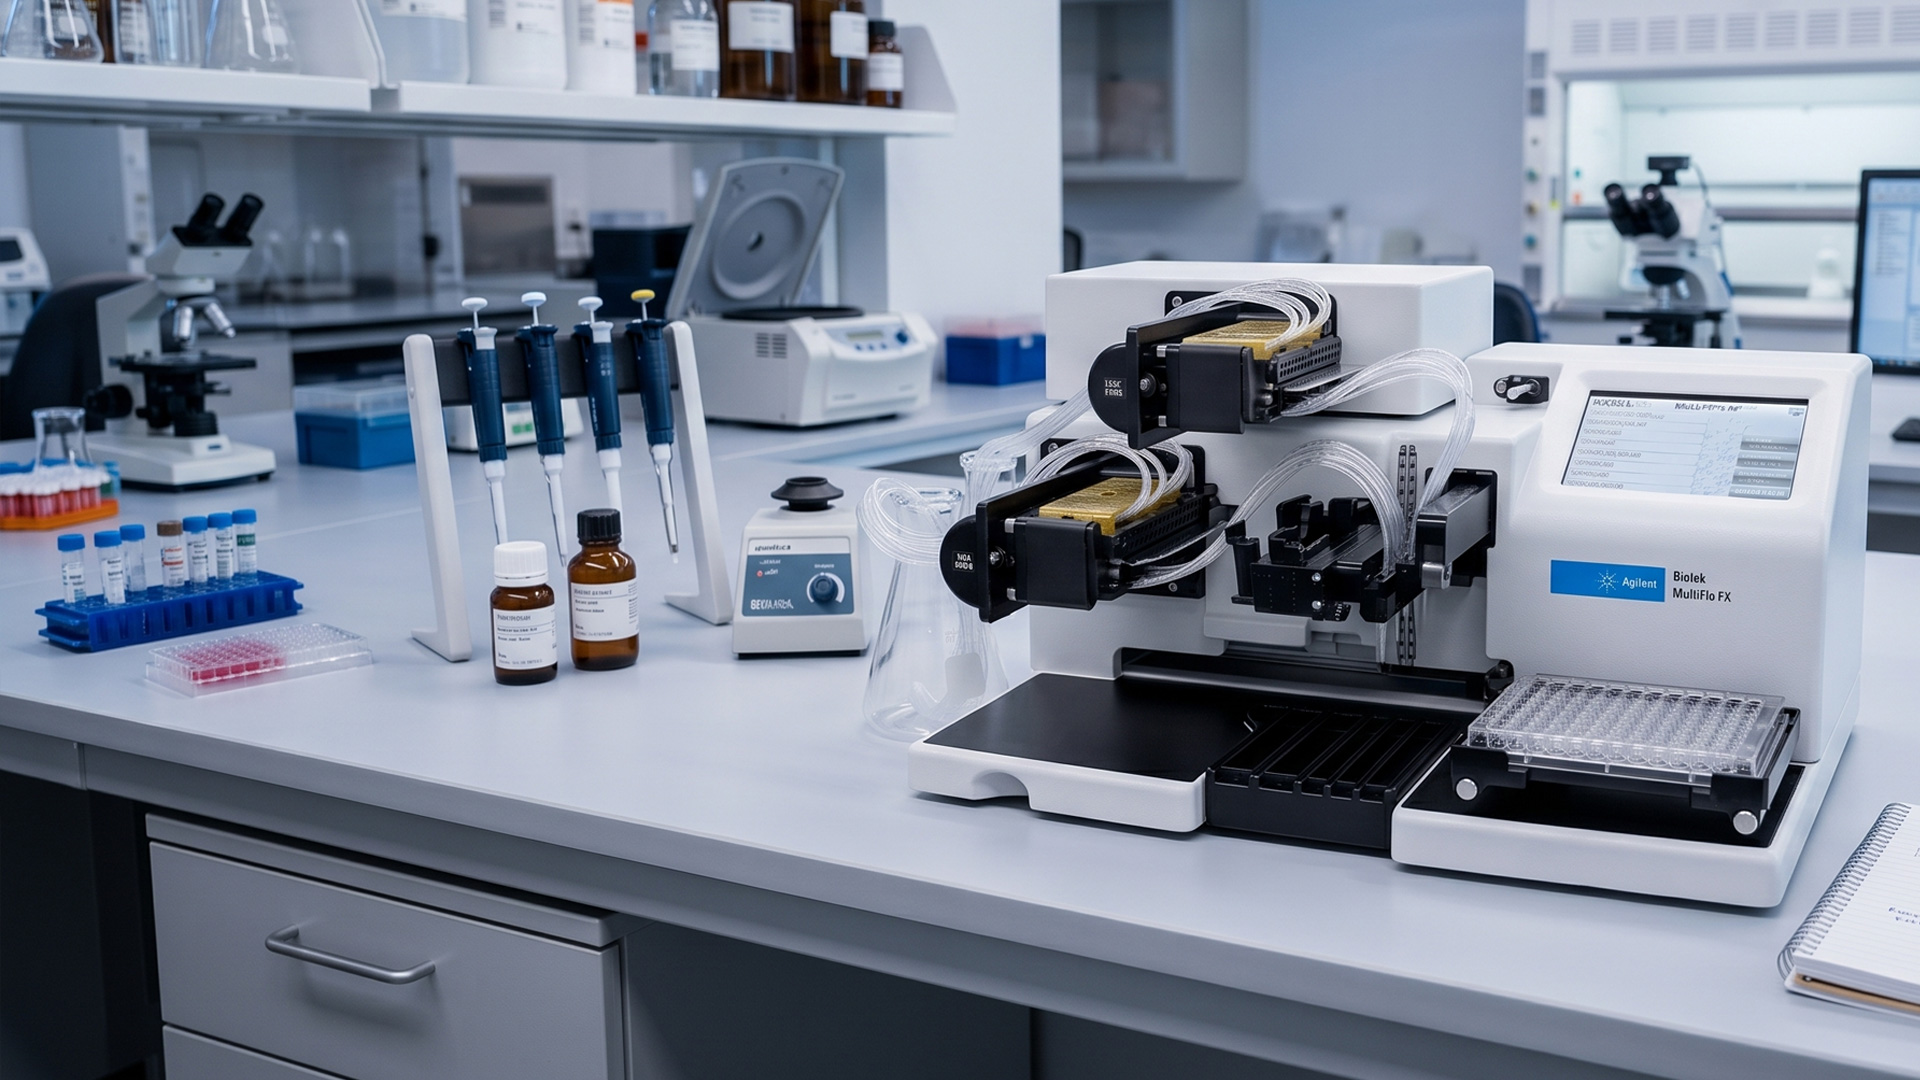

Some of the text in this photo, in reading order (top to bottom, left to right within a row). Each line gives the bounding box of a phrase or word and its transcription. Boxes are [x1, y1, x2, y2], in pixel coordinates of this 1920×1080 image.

[1621, 576, 1657, 590] Agilent
[1672, 587, 1732, 603] MultiFlo FX
